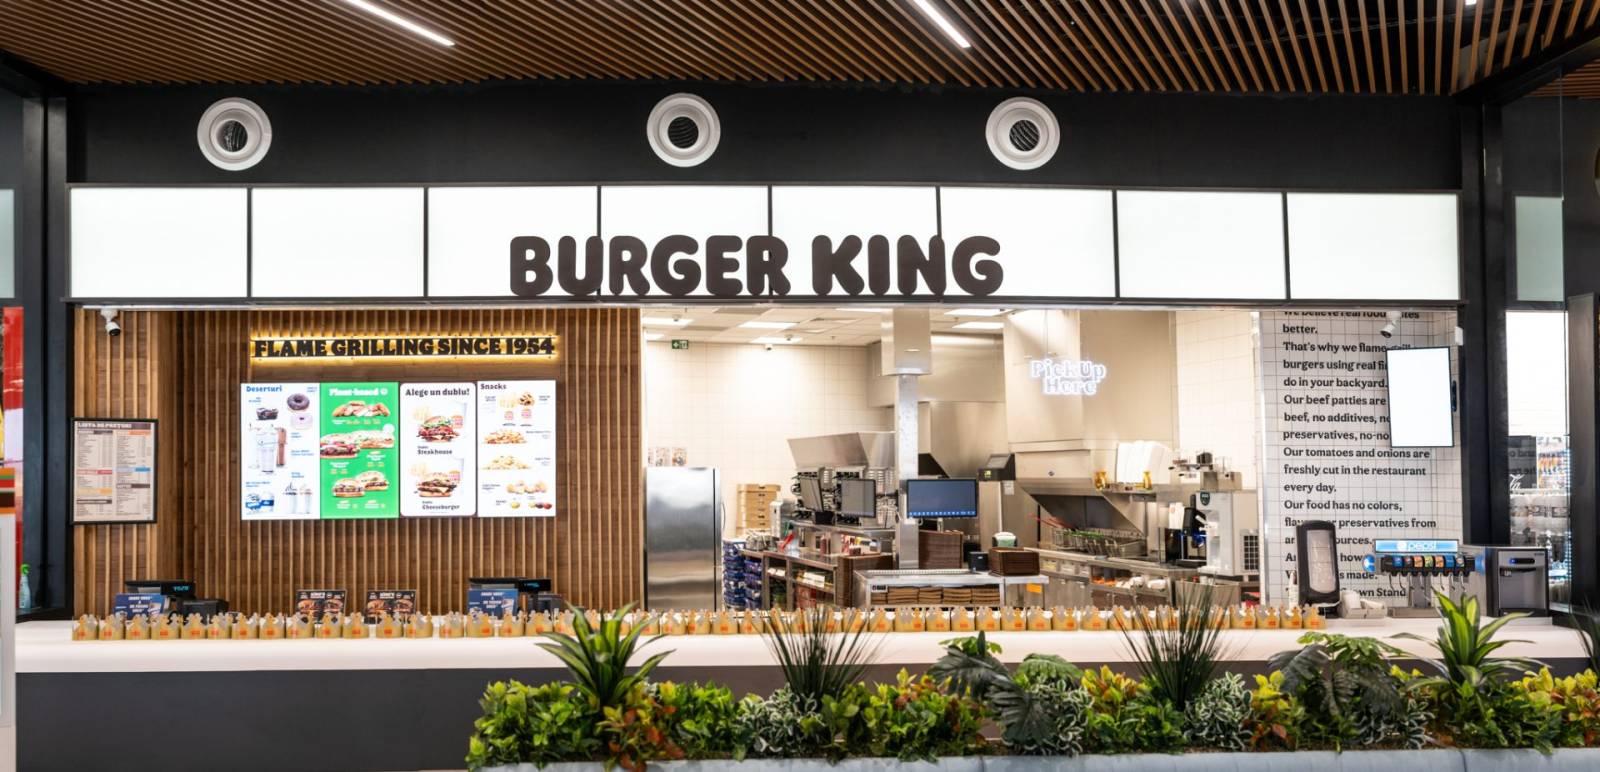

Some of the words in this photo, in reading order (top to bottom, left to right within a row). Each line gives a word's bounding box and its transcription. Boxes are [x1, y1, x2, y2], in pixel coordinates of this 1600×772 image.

[509, 234, 792, 297] BURGER
[812, 234, 1004, 297] KING
[1282, 323, 1318, 334] better.
[254, 339, 328, 357] FLAME
[331, 338, 434, 356] GRILLING
[437, 337, 501, 355] SINCE
[505, 337, 555, 355] 1954
[1283, 341, 1316, 351] That's
[1318, 342, 1339, 354] why
[1283, 360, 1325, 371] burgers
[1327, 360, 1354, 372] using
[1356, 360, 1376, 370] real
[246, 385, 282, 393] Deserturi
[1043, 376, 1097, 396] Here
[1283, 377, 1297, 387] do
[1298, 377, 1309, 387] in
[1310, 379, 1334, 389] your
[1336, 378, 1388, 390] backyard.
[405, 388, 429, 398] Alege
[442, 388, 470, 396] dublu!
[1283, 394, 1304, 404] Our
[1306, 394, 1330, 405] beef
[1332, 396, 1367, 407] patties
[1369, 398, 1387, 406] are
[1283, 412, 1310, 423] beef,
[1328, 413, 1377, 424] additives,
[1282, 430, 1358, 441] preservatives,
[1359, 432, 1390, 441] no-no
[1283, 447, 1304, 457] Our
[1305, 448, 1354, 457] tomatoes
[1356, 448, 1375, 458] and
[1377, 448, 1411, 458] onions
[1283, 464, 1321, 477] freshly
[1322, 466, 1340, 475] cut
[1341, 465, 1350, 475] in
[1352, 465, 1370, 475] the
[1371, 467, 1426, 476] restaurant
[1283, 484, 1314, 494] every
[1315, 483, 1337, 494] day.
[1284, 499, 1305, 510] Our
[1306, 499, 1331, 510] food
[1332, 500, 1350, 510] has
[1352, 502, 1366, 510] no
[1367, 500, 1403, 512] colors,
[1338, 517, 1410, 529] preservatives
[1411, 517, 1437, 528] from
[1336, 537, 1373, 545] ources.
[1407, 541, 1437, 551] pepsi
[1340, 553, 1362, 562] how
[1376, 587, 1407, 597] Stand
